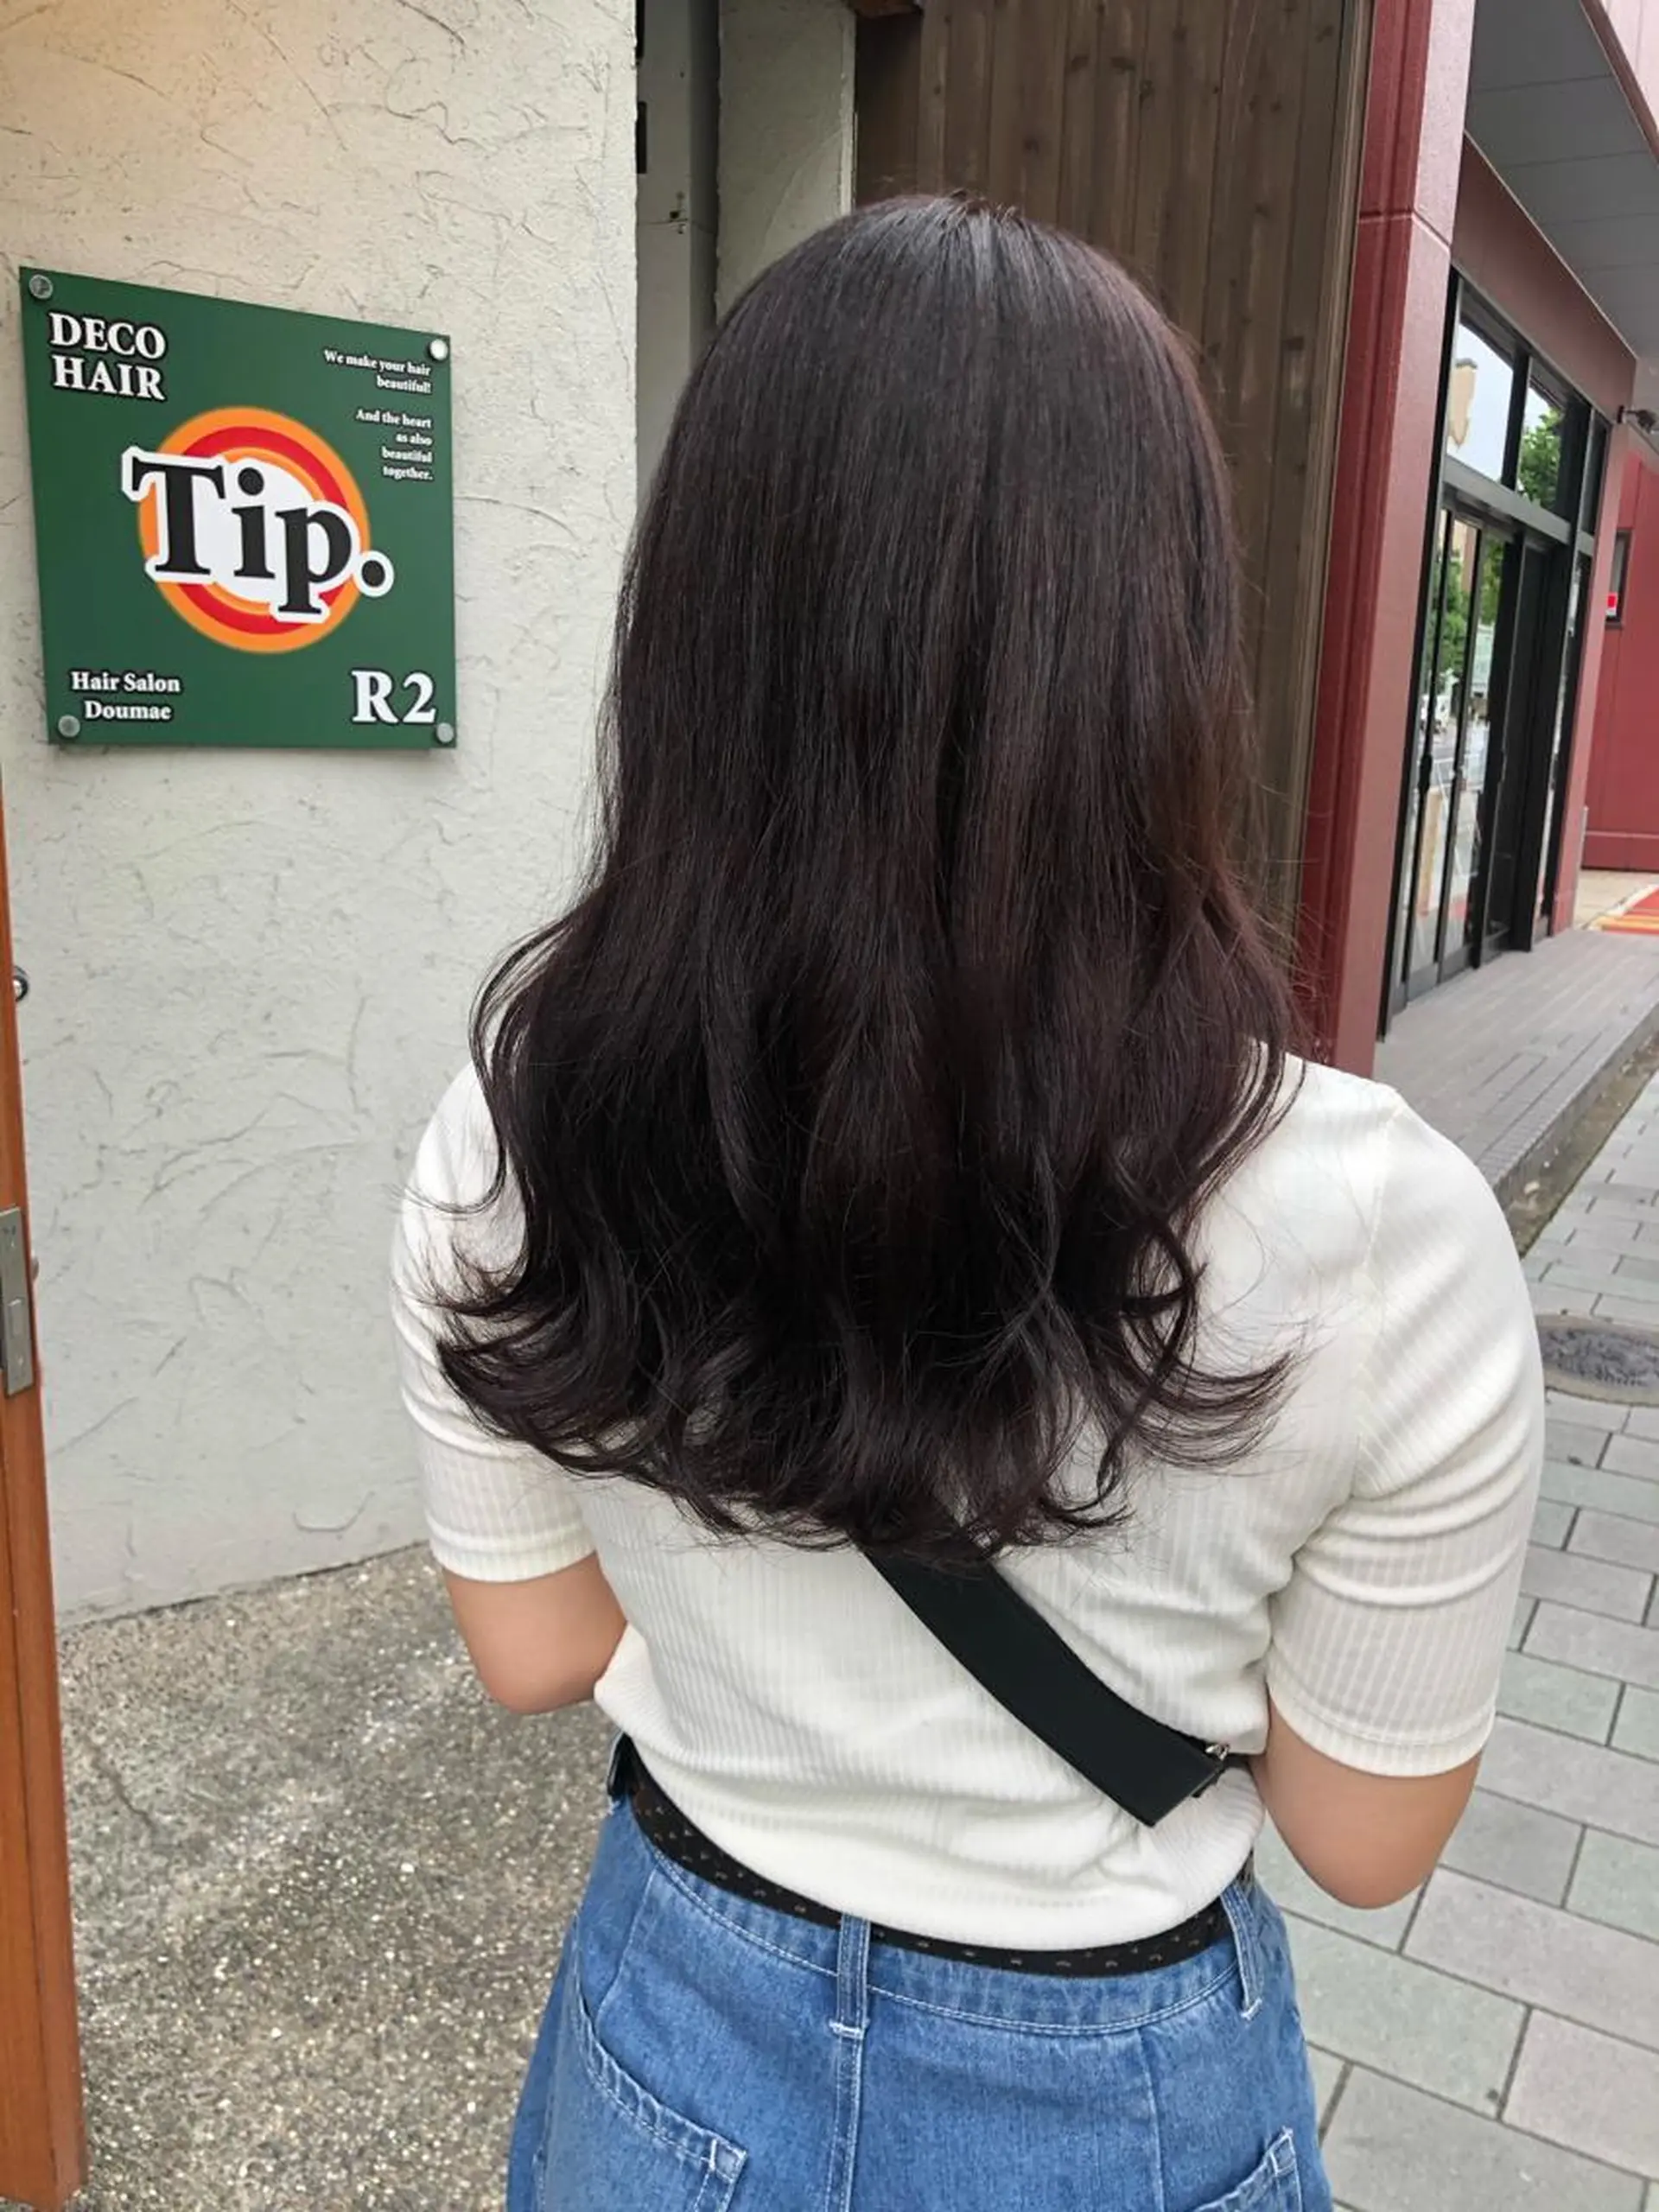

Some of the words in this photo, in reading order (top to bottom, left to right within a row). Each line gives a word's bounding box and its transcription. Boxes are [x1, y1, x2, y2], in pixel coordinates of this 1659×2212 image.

[48, 312, 167, 359] DECO
[324, 349, 344, 363] We
[346, 355, 378, 369] make
[379, 359, 405, 373] your
[407, 361, 430, 375] hair
[51, 354, 166, 401] HAIR
[377, 375, 431, 393] beautiful!
[355, 409, 380, 423] And
[381, 411, 401, 424] the
[402, 413, 431, 429] heart
[410, 432, 433, 446] also
[381, 445, 433, 463] beautiful
[383, 465, 433, 480] together.
[71, 671, 120, 690] Hair
[123, 671, 181, 692] Salon
[351, 669, 437, 725] R2
[84, 699, 172, 720] Doumae
